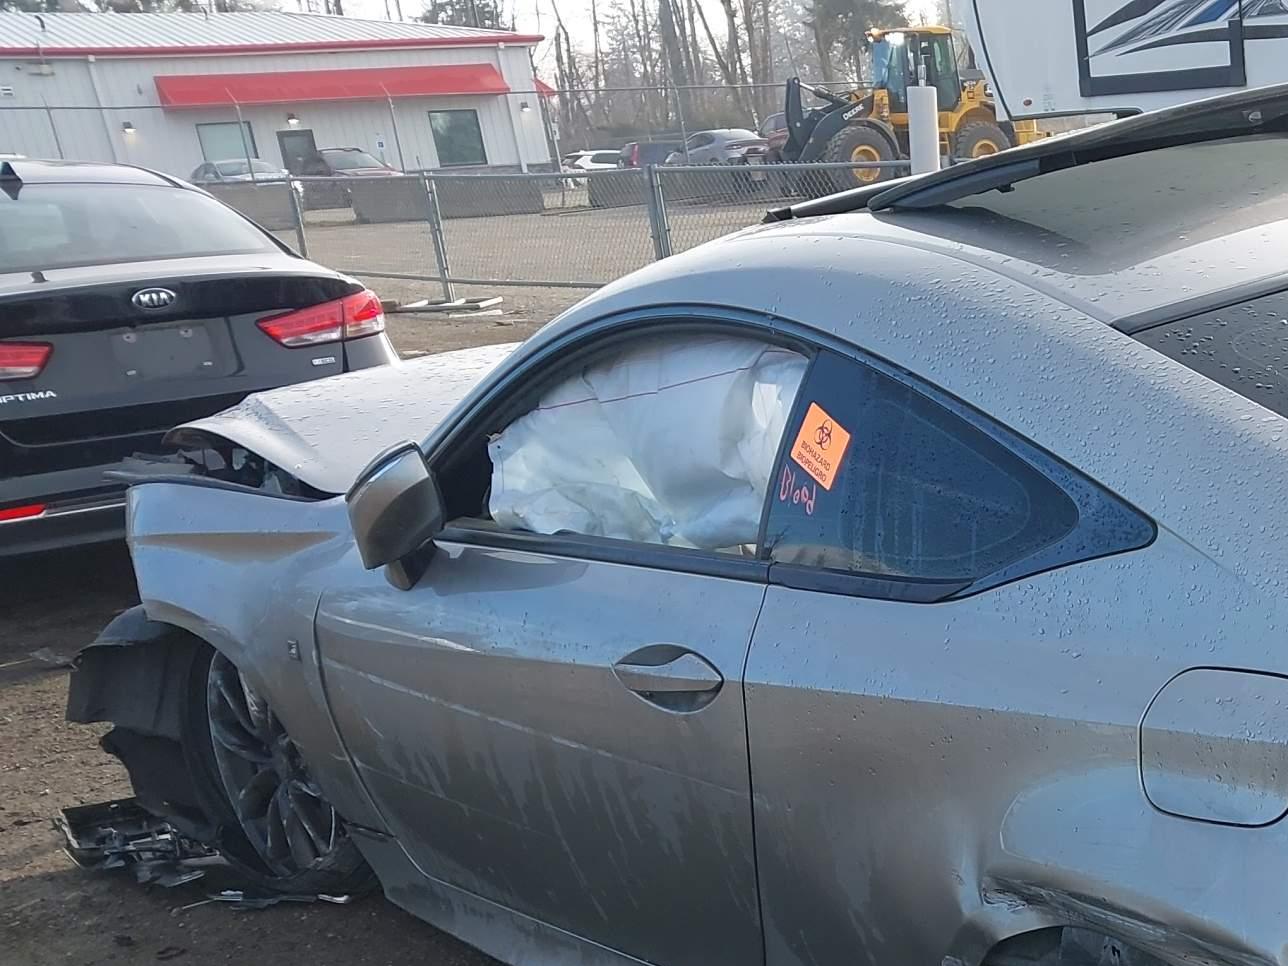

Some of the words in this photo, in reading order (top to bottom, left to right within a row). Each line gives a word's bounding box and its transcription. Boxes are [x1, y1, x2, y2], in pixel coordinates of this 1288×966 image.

[839, 103, 865, 121] DEERE
[138, 291, 170, 306] KIA
[0, 390, 57, 404] PTIMA
[800, 440, 831, 472] BIOHAZARD
